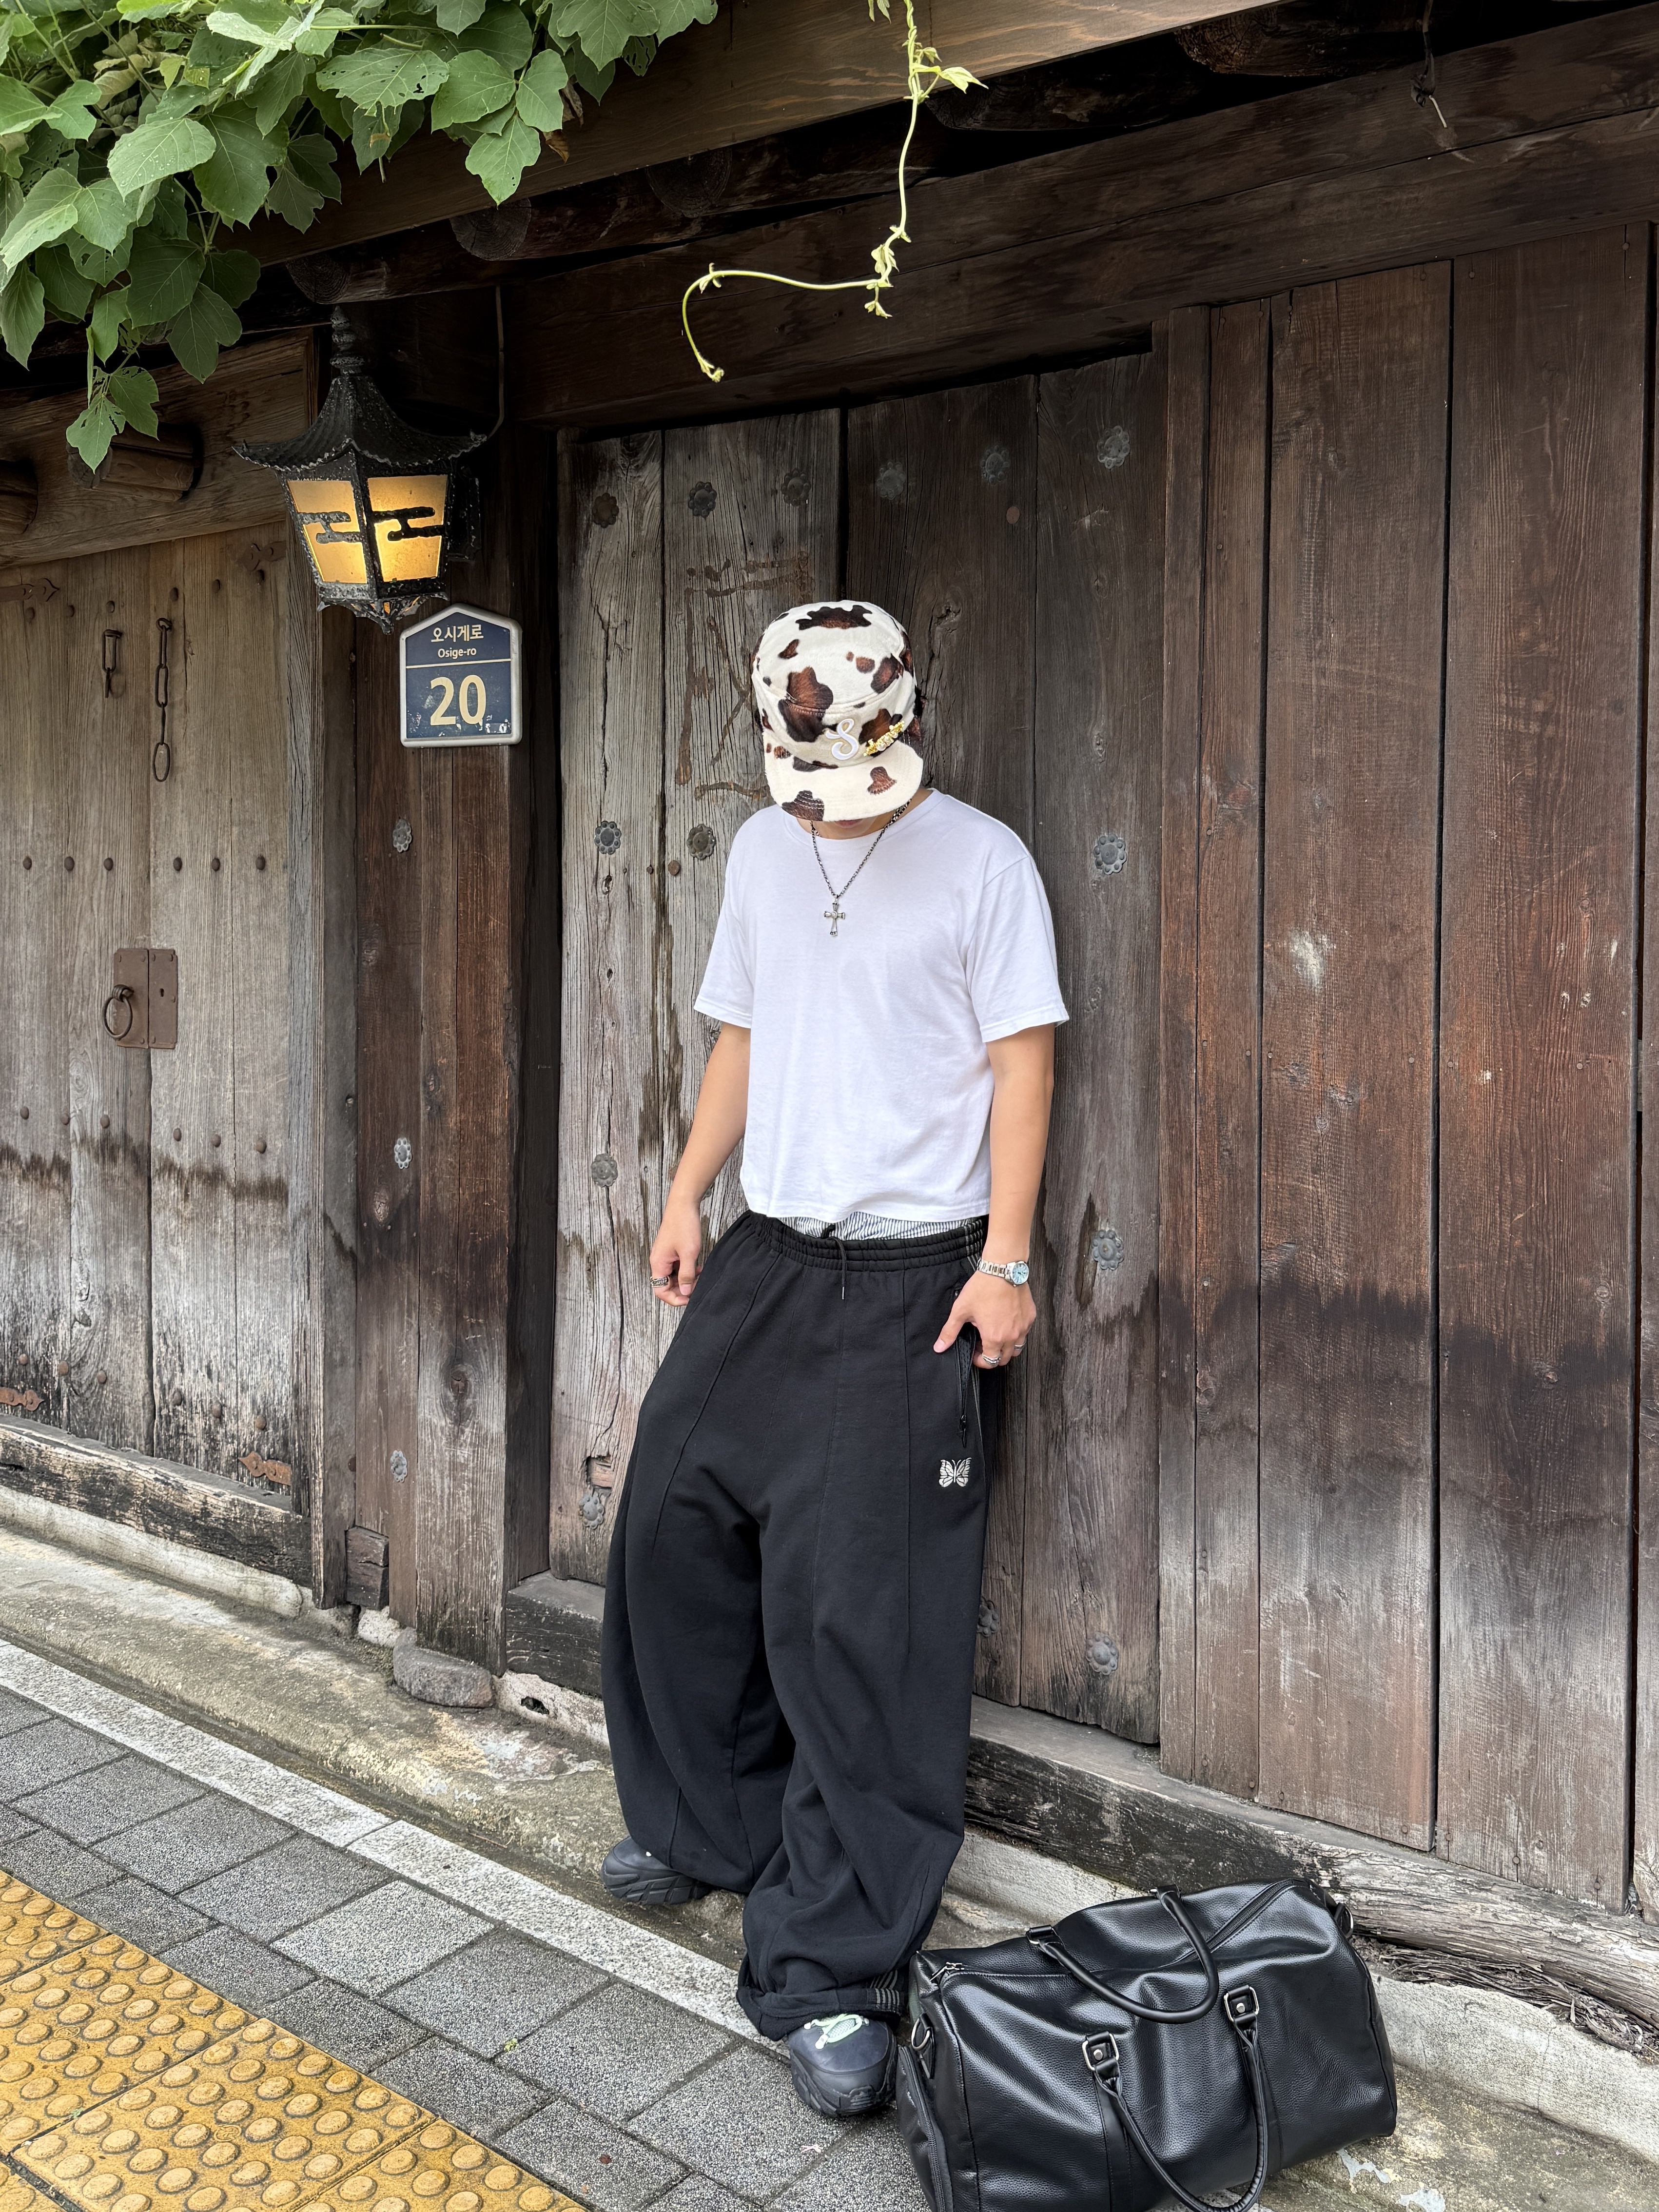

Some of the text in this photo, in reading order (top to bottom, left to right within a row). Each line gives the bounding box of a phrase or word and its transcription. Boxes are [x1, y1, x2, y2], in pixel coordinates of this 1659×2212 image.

[431, 624, 484, 643] 오시게로
[438, 647, 477, 660] Osige-ro
[430, 674, 487, 725] 20
[825, 718, 859, 761] S
